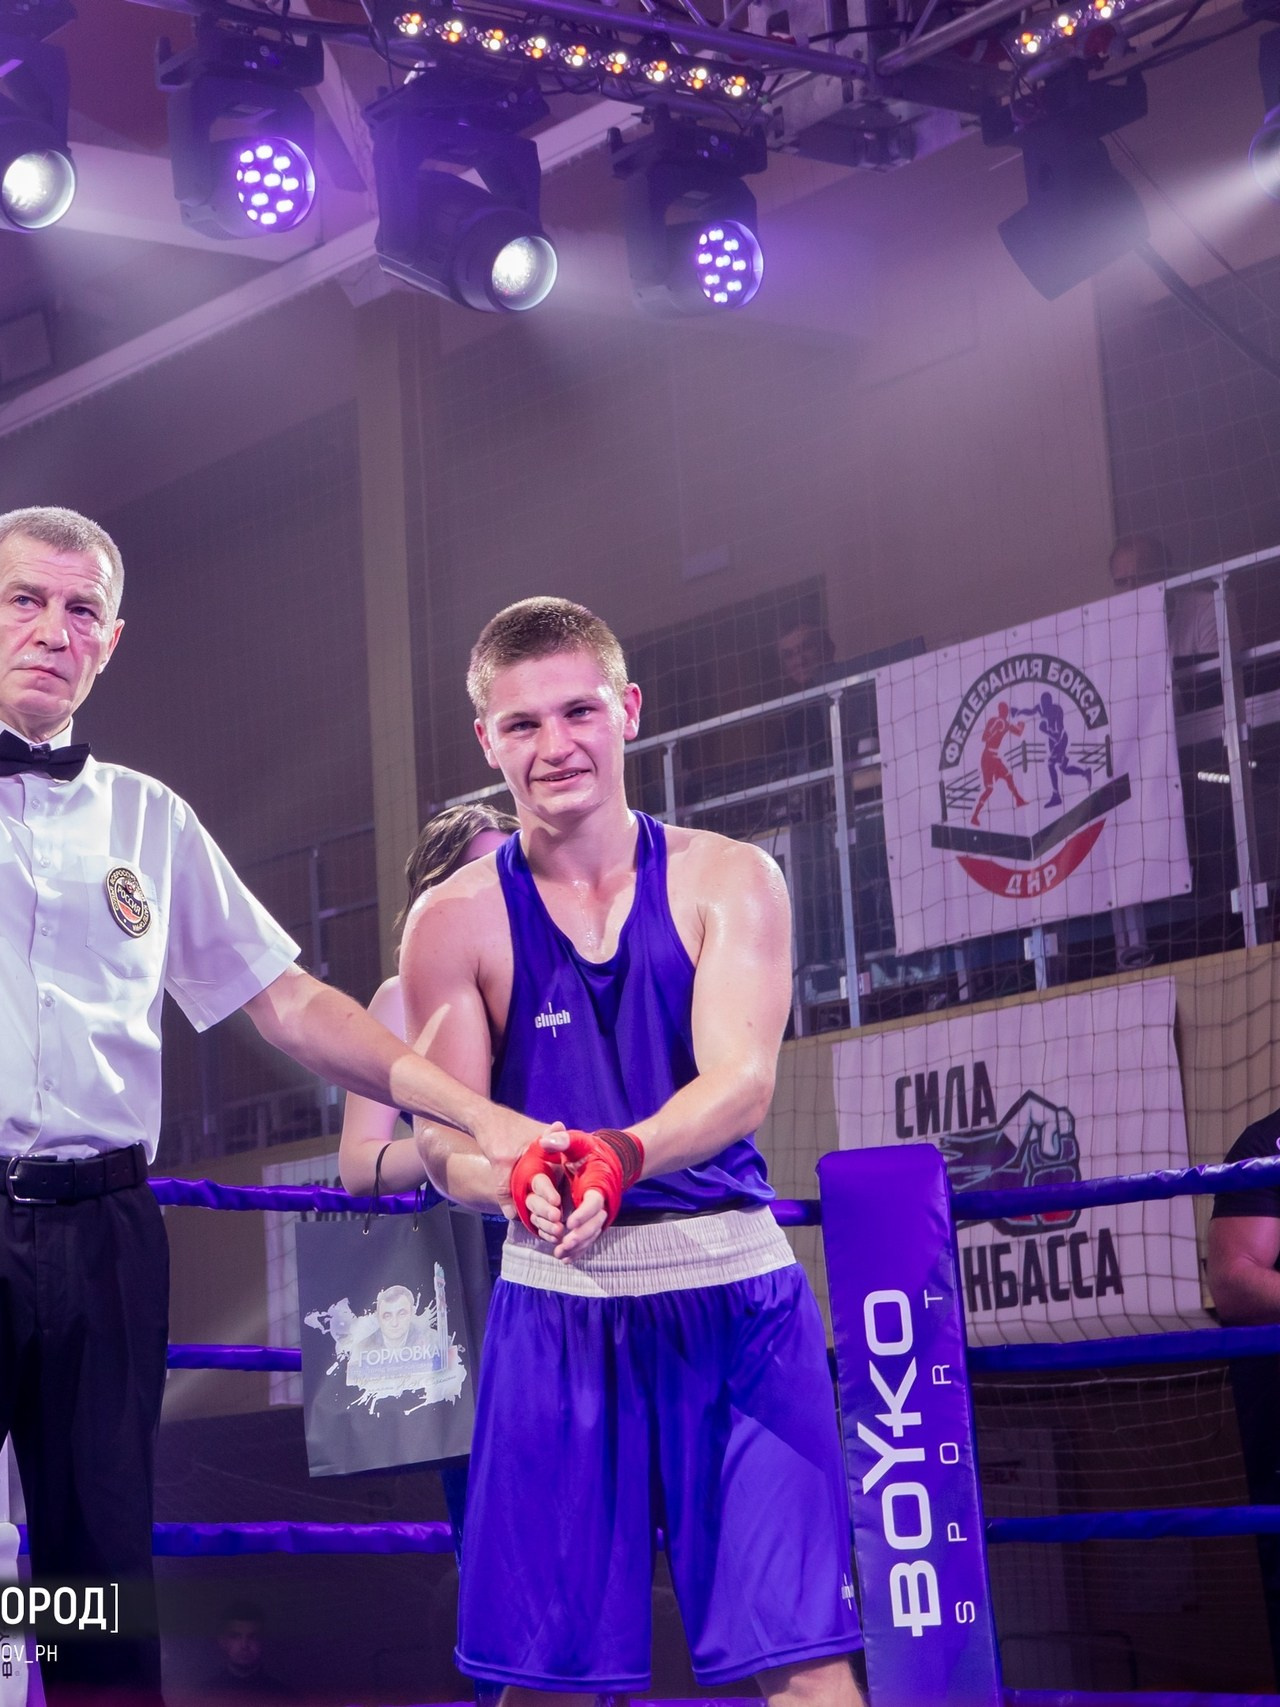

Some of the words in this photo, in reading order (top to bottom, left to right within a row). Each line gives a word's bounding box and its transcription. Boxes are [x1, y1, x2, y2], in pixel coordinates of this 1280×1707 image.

[945, 658, 1043, 764] ФЕДЕРАЦИЯ
[1047, 661, 1102, 726] БОКСА
[1004, 864, 1058, 896] ДНР
[534, 1004, 571, 1034] clinch
[895, 1060, 998, 1139] СИЛА
[963, 1228, 1124, 1312] НБАССА
[359, 1345, 440, 1367] ГОРЛОВКА
[857, 1289, 942, 1637] BOYKO
